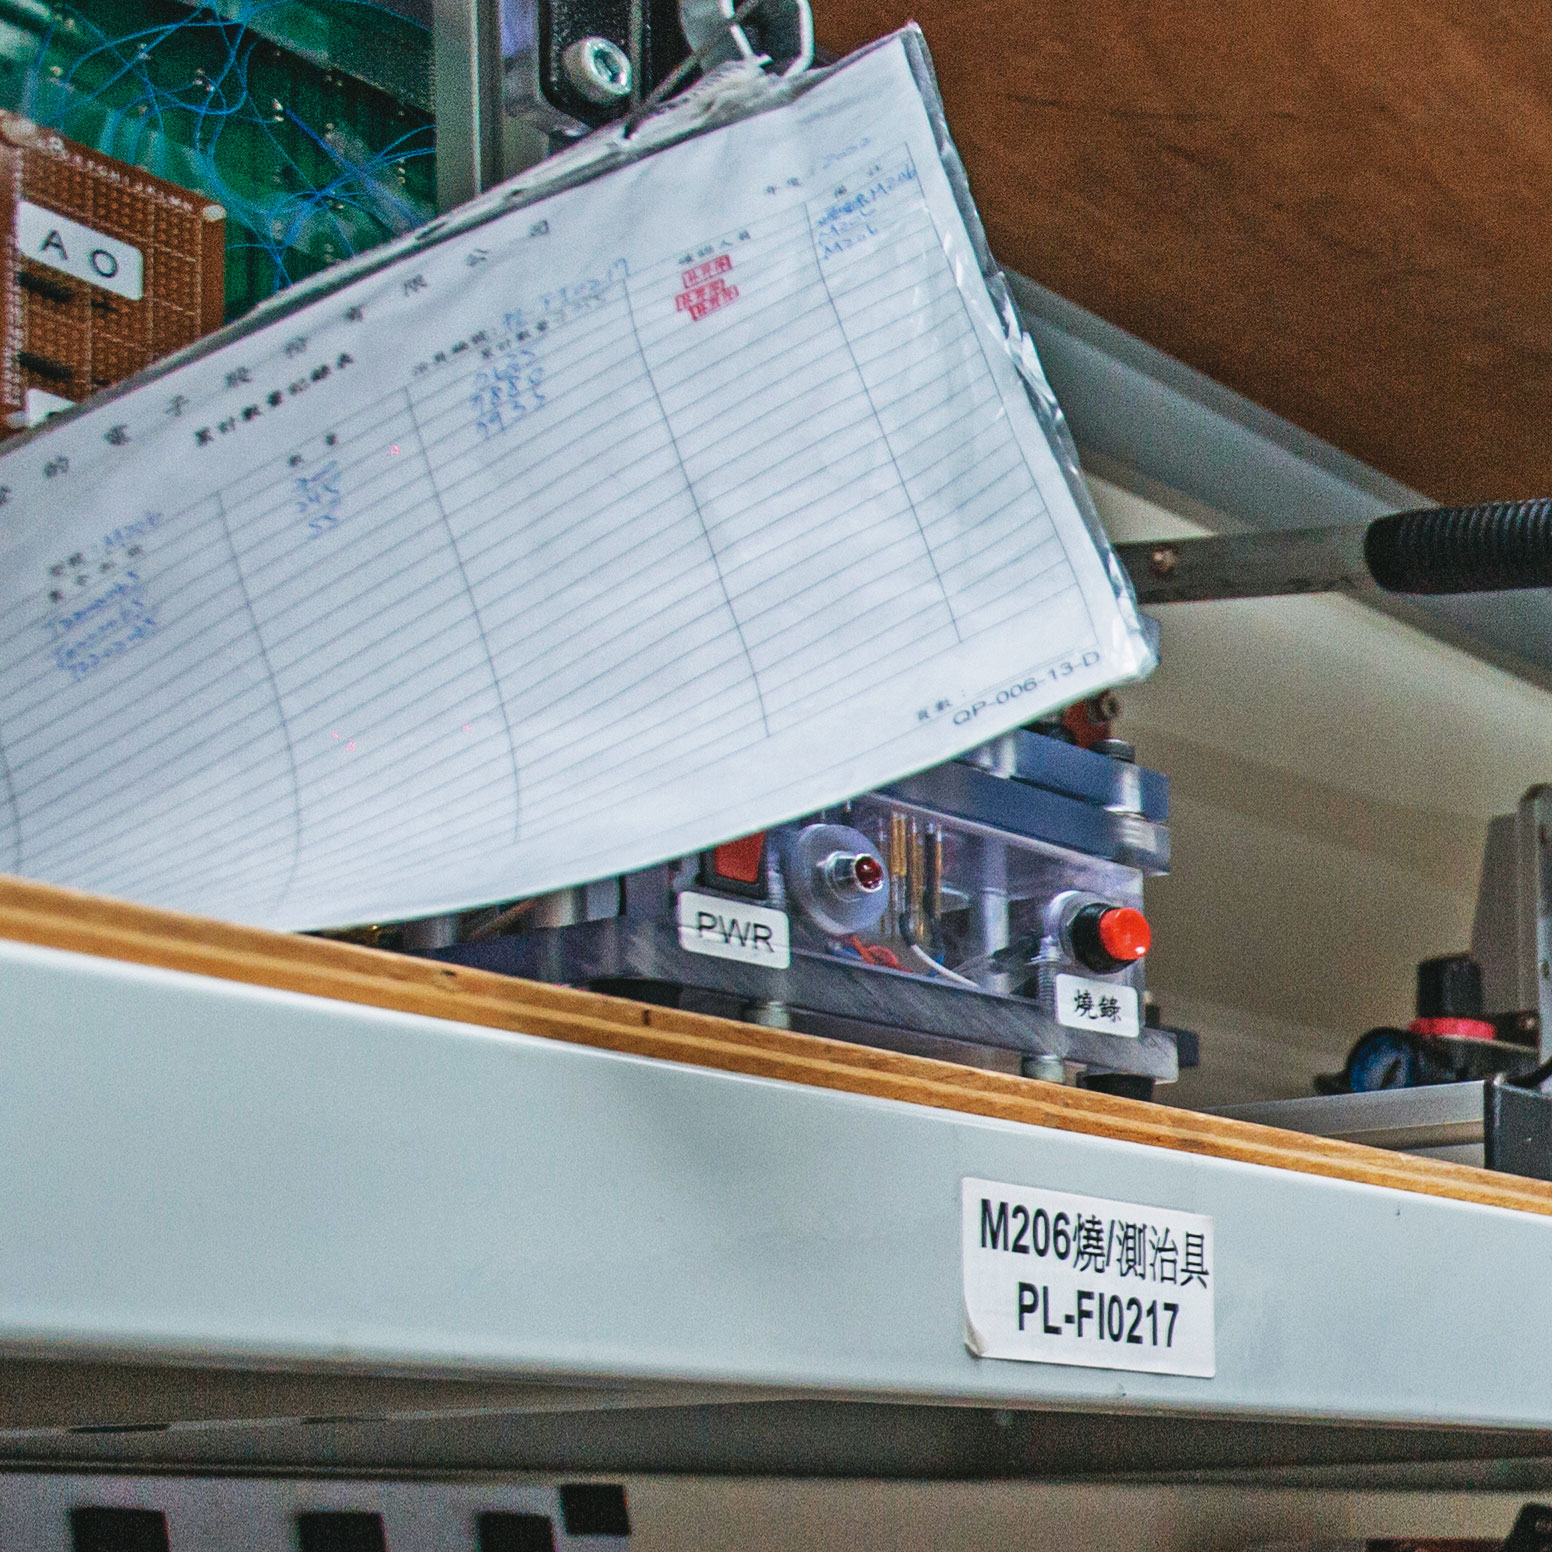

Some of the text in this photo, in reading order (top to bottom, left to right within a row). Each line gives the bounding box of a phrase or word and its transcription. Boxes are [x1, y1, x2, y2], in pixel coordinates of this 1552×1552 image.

[952, 650, 1101, 726] QP-006-13-D
[695, 909, 776, 953] PWR
[1072, 987, 1123, 1023] 燒錄
[978, 1197, 1210, 1290] M206燒/測治具
[1016, 1280, 1180, 1349] PL-FI0217
